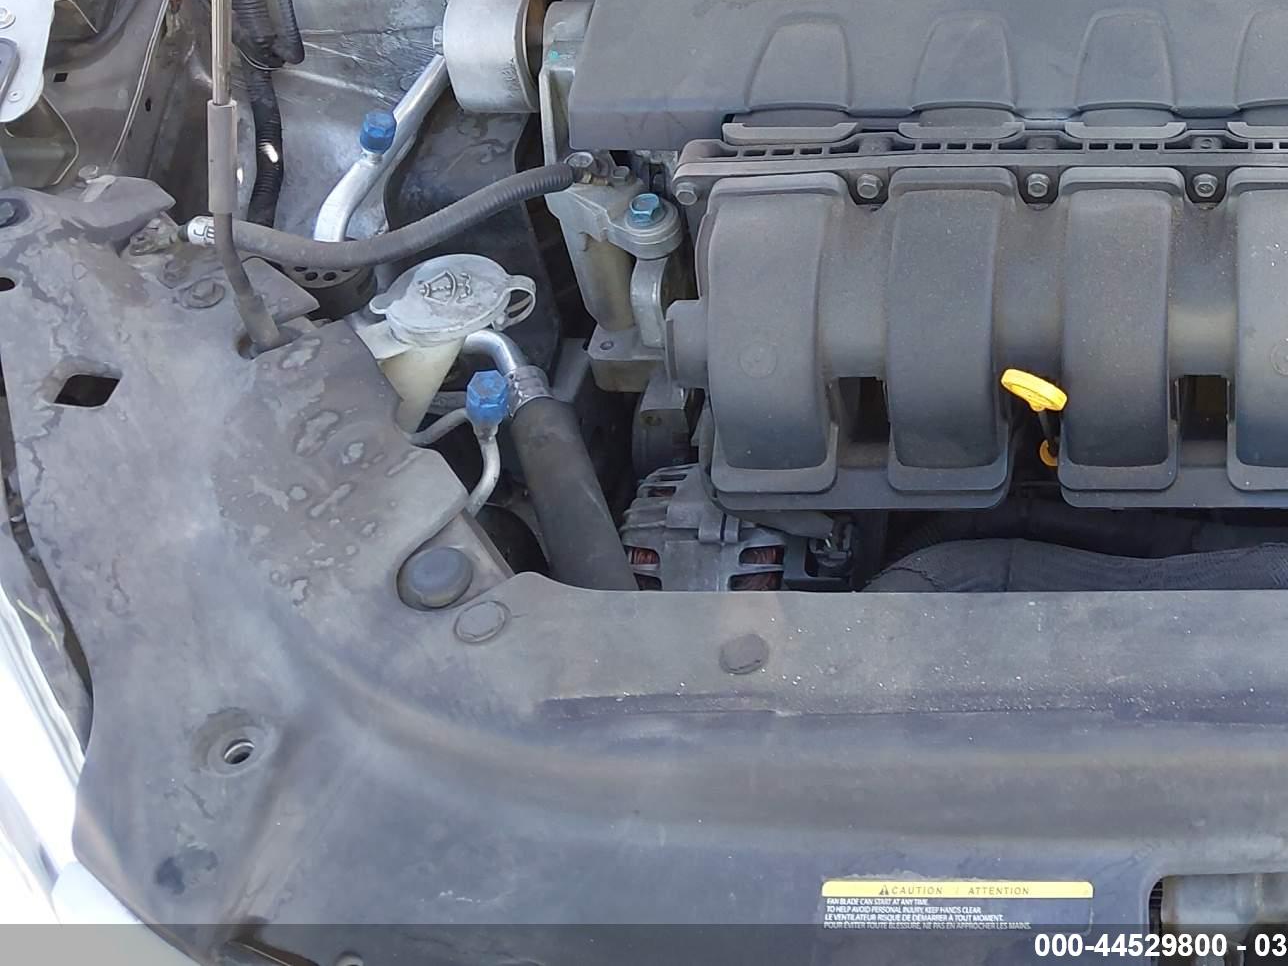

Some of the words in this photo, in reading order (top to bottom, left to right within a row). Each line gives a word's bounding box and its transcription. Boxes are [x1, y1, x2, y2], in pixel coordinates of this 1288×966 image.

[891, 886, 944, 895] CAUTION
[968, 886, 1030, 896] ATTENTION
[826, 897, 839, 905] FAN
[839, 897, 859, 905] BLADE
[860, 897, 873, 905] CAN
[874, 897, 891, 905] START
[892, 897, 900, 905] AT
[901, 897, 914, 905] ANY
[826, 905, 836, 914] TO
[836, 905, 851, 914] HELP
[852, 905, 871, 914] AVOID
[872, 905, 902, 914] PERSONAL
[924, 905, 939, 914] KEEP
[940, 905, 961, 914] HANDS
[824, 913, 832, 922] LE
[832, 913, 877, 922] VENTILATEUR
[877, 913, 901, 922] RISQUE
[902, 913, 911, 922] DE
[954, 913, 972, 922] TOUT
[823, 921, 843, 930] POUR
[866, 921, 888, 930] TOUTE
[922, 921, 932, 930] NE
[932, 921, 946, 930] PAS
[946, 921, 955, 930] EN
[955, 921, 995, 930] APPROCHER
[996, 921, 1008, 930] LES
